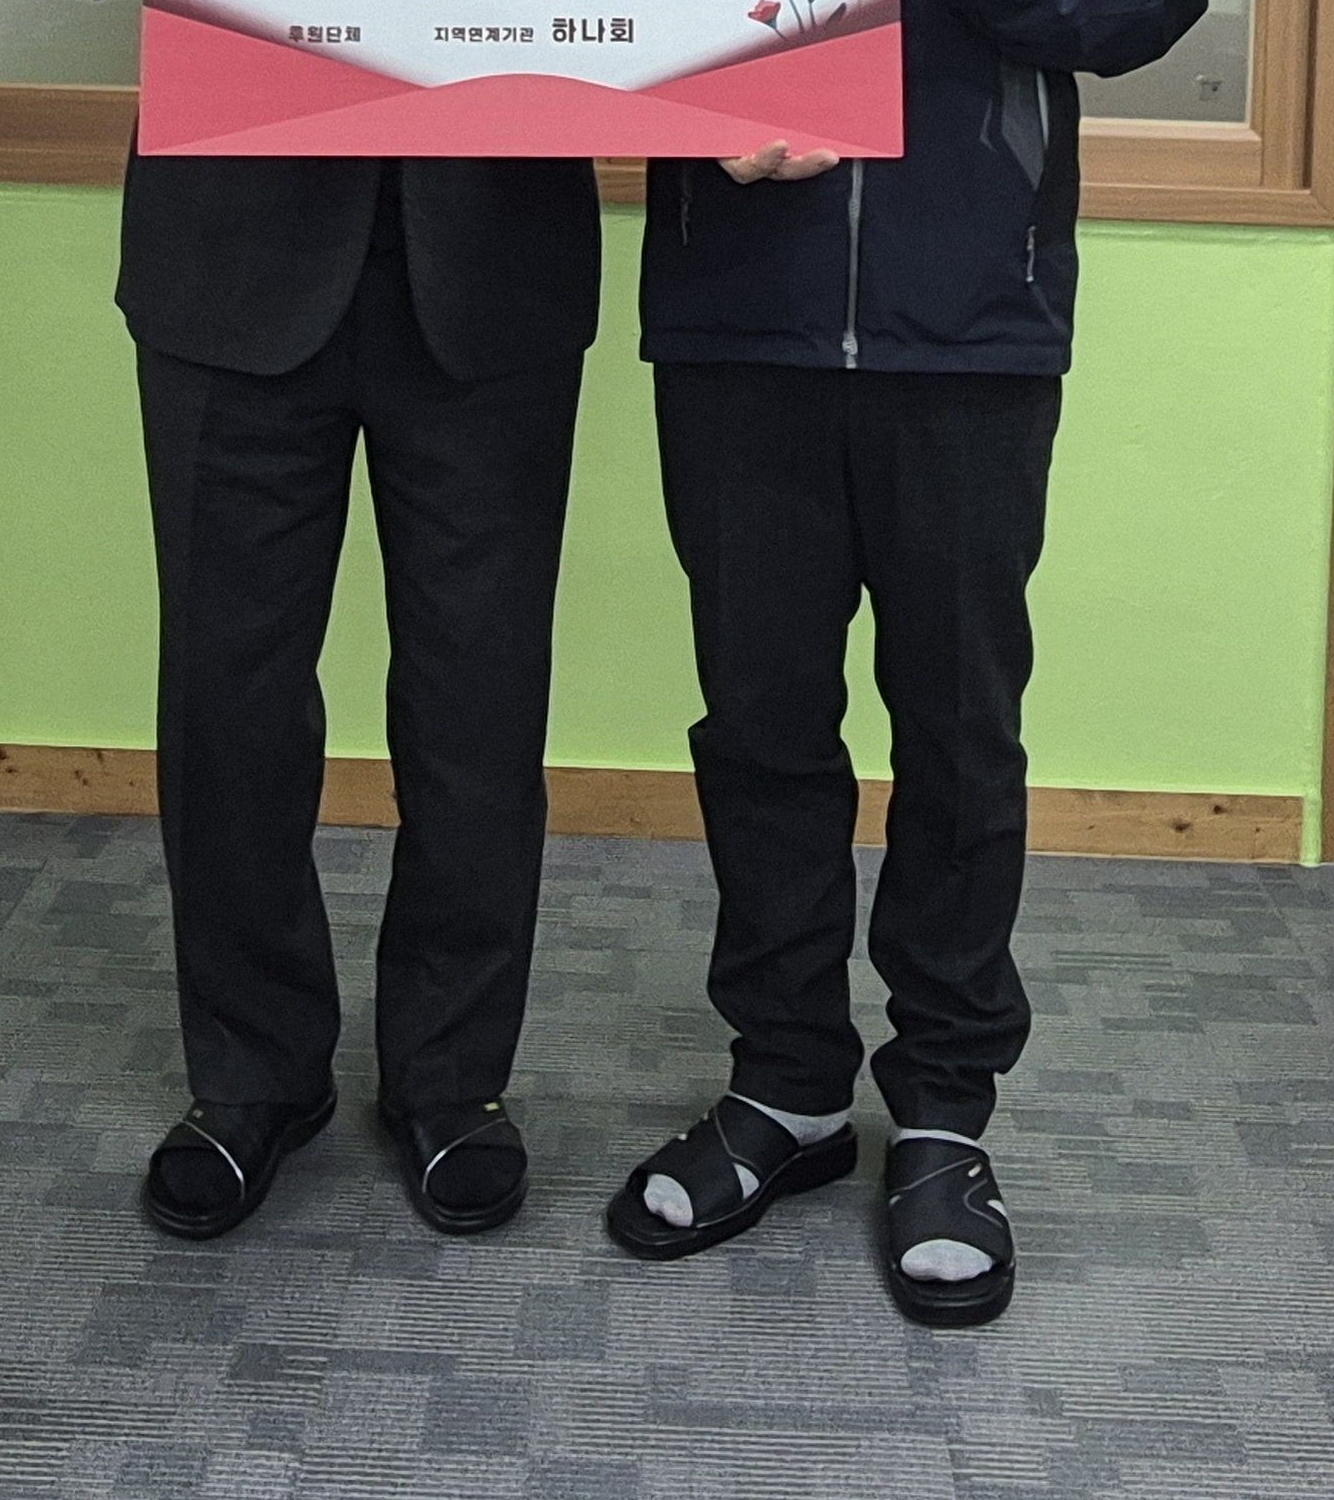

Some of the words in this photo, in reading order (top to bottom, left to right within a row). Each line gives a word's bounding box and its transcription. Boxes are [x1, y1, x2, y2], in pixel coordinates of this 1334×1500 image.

[288, 25, 361, 43] 후원단체
[434, 26, 534, 43] 지역연계기관
[552, 18, 634, 44] 하나회
